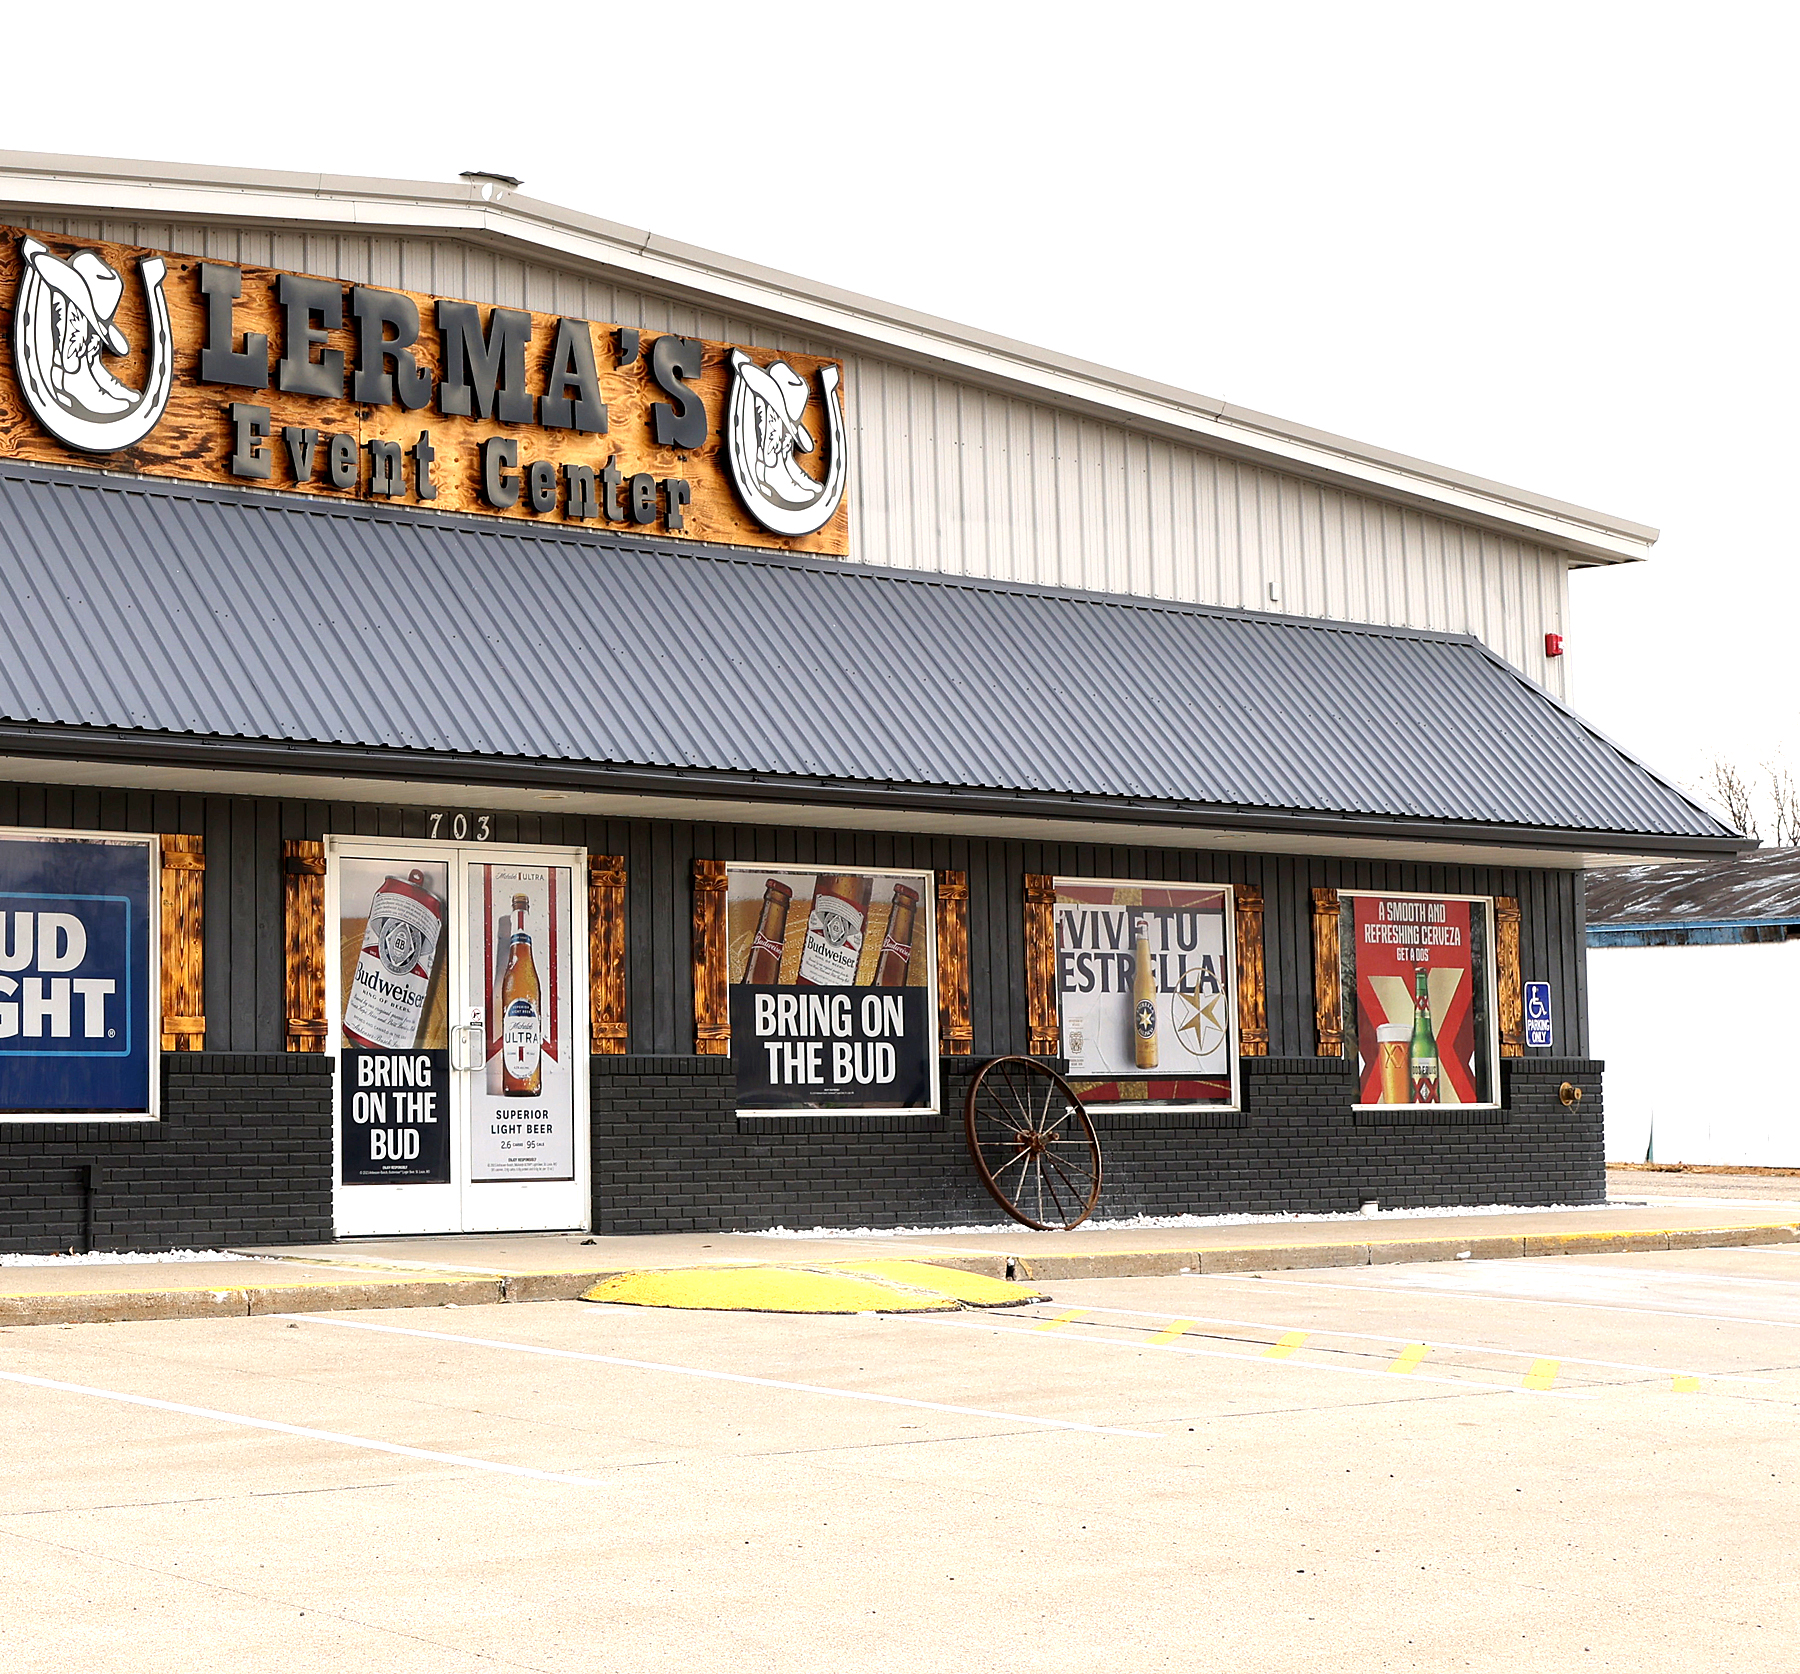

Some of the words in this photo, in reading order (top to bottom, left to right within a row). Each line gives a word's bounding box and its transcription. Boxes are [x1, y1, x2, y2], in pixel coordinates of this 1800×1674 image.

[199, 261, 707, 450] LERMA'S
[230, 403, 437, 500] Event
[484, 439, 691, 531] Center
[430, 813, 490, 841] 703
[1378, 901, 1385, 921] A
[1386, 901, 1426, 922] SMOOTH
[1427, 903, 1446, 923] AND
[1154, 912, 1198, 952] TU
[1364, 923, 1420, 945] REFRESHING
[1421, 925, 1461, 946] CERVEZA
[807, 935, 856, 969] Budweiser
[1396, 947, 1409, 961] GET
[1409, 947, 1415, 961] A
[1415, 947, 1429, 962] DOS
[755, 993, 852, 1037] BRING
[861, 994, 904, 1037] ON
[1528, 1019, 1550, 1031] PARKING
[505, 1031, 539, 1044] ULTRA
[1532, 1031, 1547, 1043] ONLY
[357, 1055, 431, 1087] BRING
[764, 1041, 825, 1084] THE
[832, 1041, 896, 1085] BUD
[352, 1091, 386, 1124] ON
[392, 1091, 438, 1123] THE
[495, 1109, 549, 1120] SUPERIOR
[490, 1124, 522, 1134] LIGHT
[526, 1124, 553, 1134] BEER
[370, 1128, 420, 1160] BUD
[526, 1140, 536, 1149] 95
